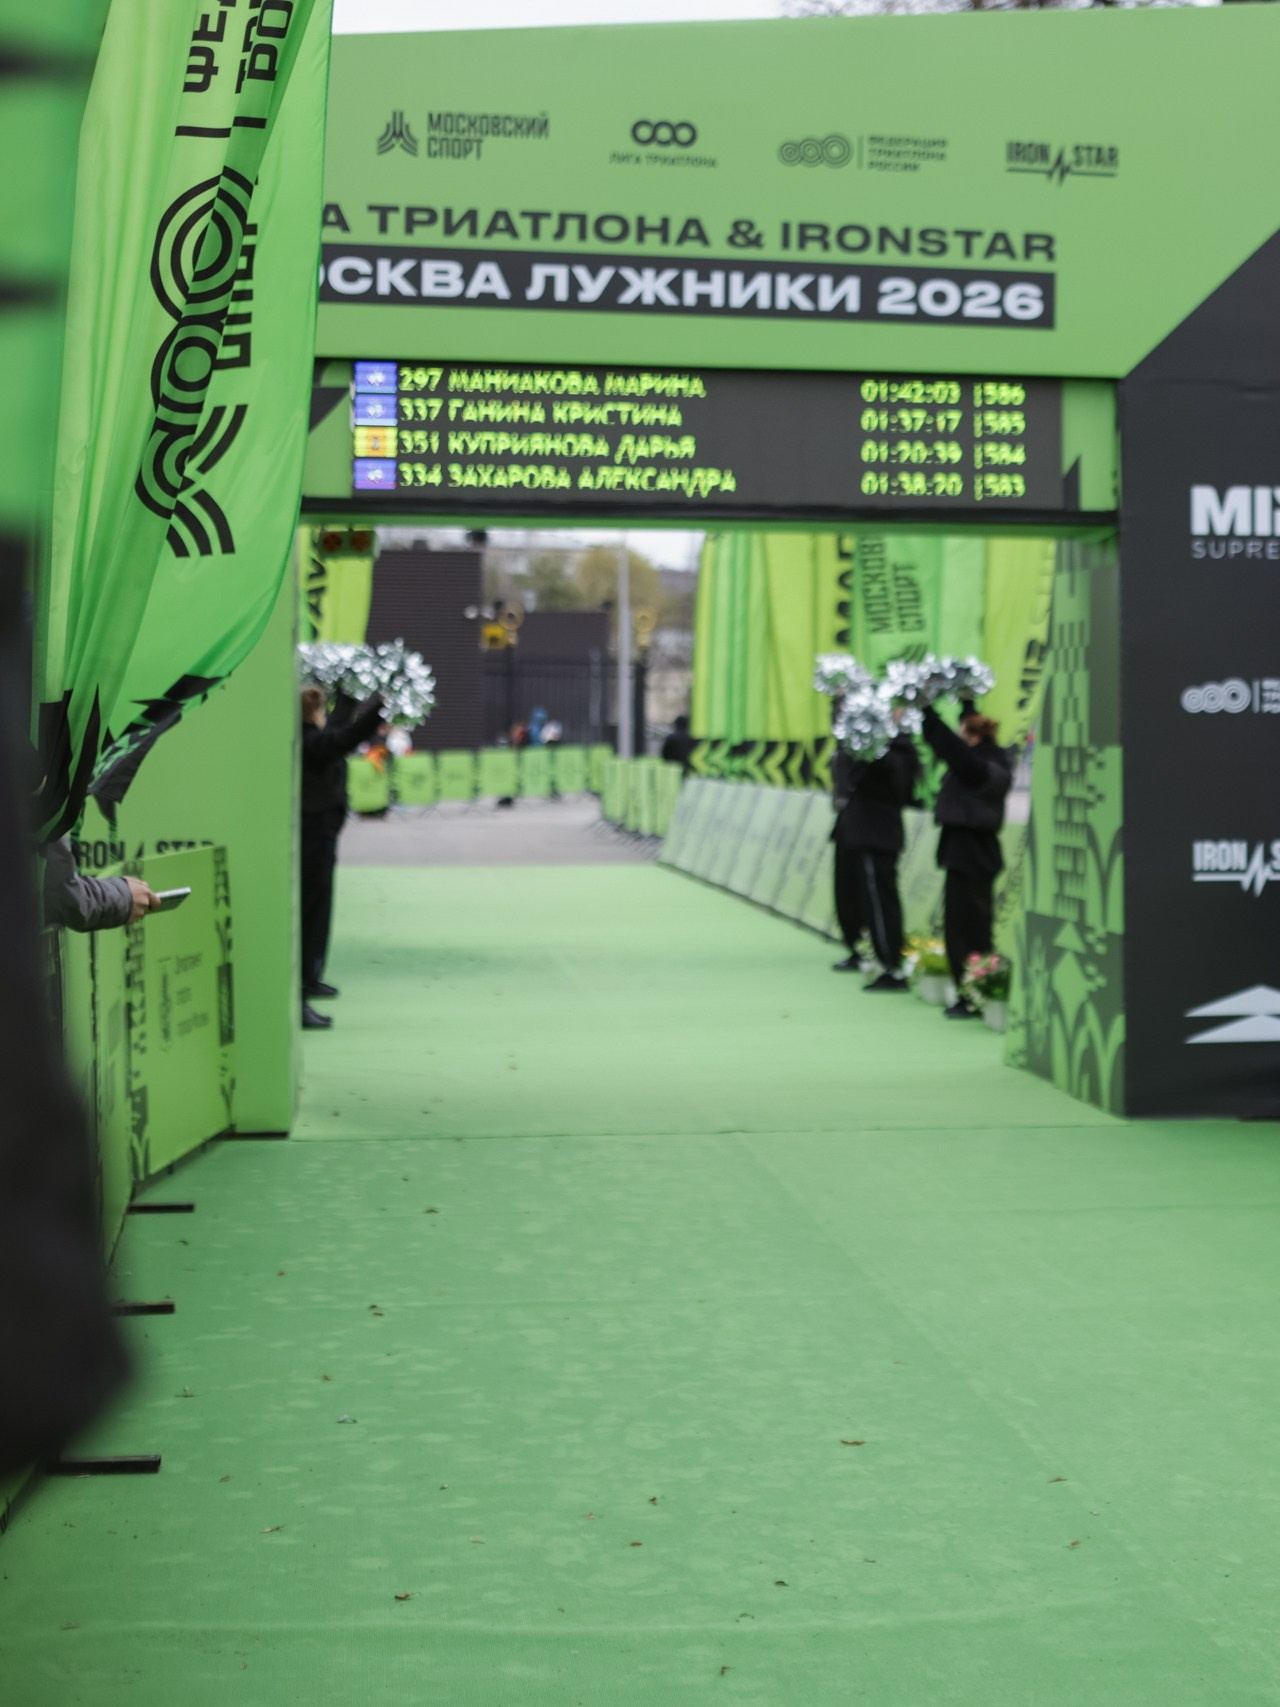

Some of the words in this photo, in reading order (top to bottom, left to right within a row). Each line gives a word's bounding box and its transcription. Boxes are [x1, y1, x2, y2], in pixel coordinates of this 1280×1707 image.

[427, 110, 549, 139] МОСКОВСКИЙ
[427, 137, 483, 161] СПОРТ
[1006, 141, 1050, 164] IRON
[1073, 144, 1119, 168] STAR
[367, 204, 711, 249] ТРИАТЛОНА
[727, 219, 766, 249] &
[781, 221, 1056, 263] IRONSTAR
[320, 256, 512, 301] СКВА
[525, 263, 862, 314] ЛУЖНИКИ
[877, 276, 1045, 320] 2026
[400, 367, 444, 393] 297
[604, 371, 708, 399] МАРИНА
[400, 397, 444, 424] 337
[448, 398, 547, 424] ГАНИНА
[552, 399, 684, 428] КРИСТИНА
[860, 407, 963, 434] 01:37:17
[400, 429, 441, 455] 351
[448, 430, 611, 458] КУПРИЯНОВА
[614, 433, 697, 465] ДАРЬЯ
[400, 461, 444, 489] 334
[448, 462, 573, 491] ЗАХАРОВА
[577, 465, 738, 499] АЛЕКСАНДРА
[893, 562, 926, 632] СПОРТ
[1193, 840, 1248, 871] IRON
